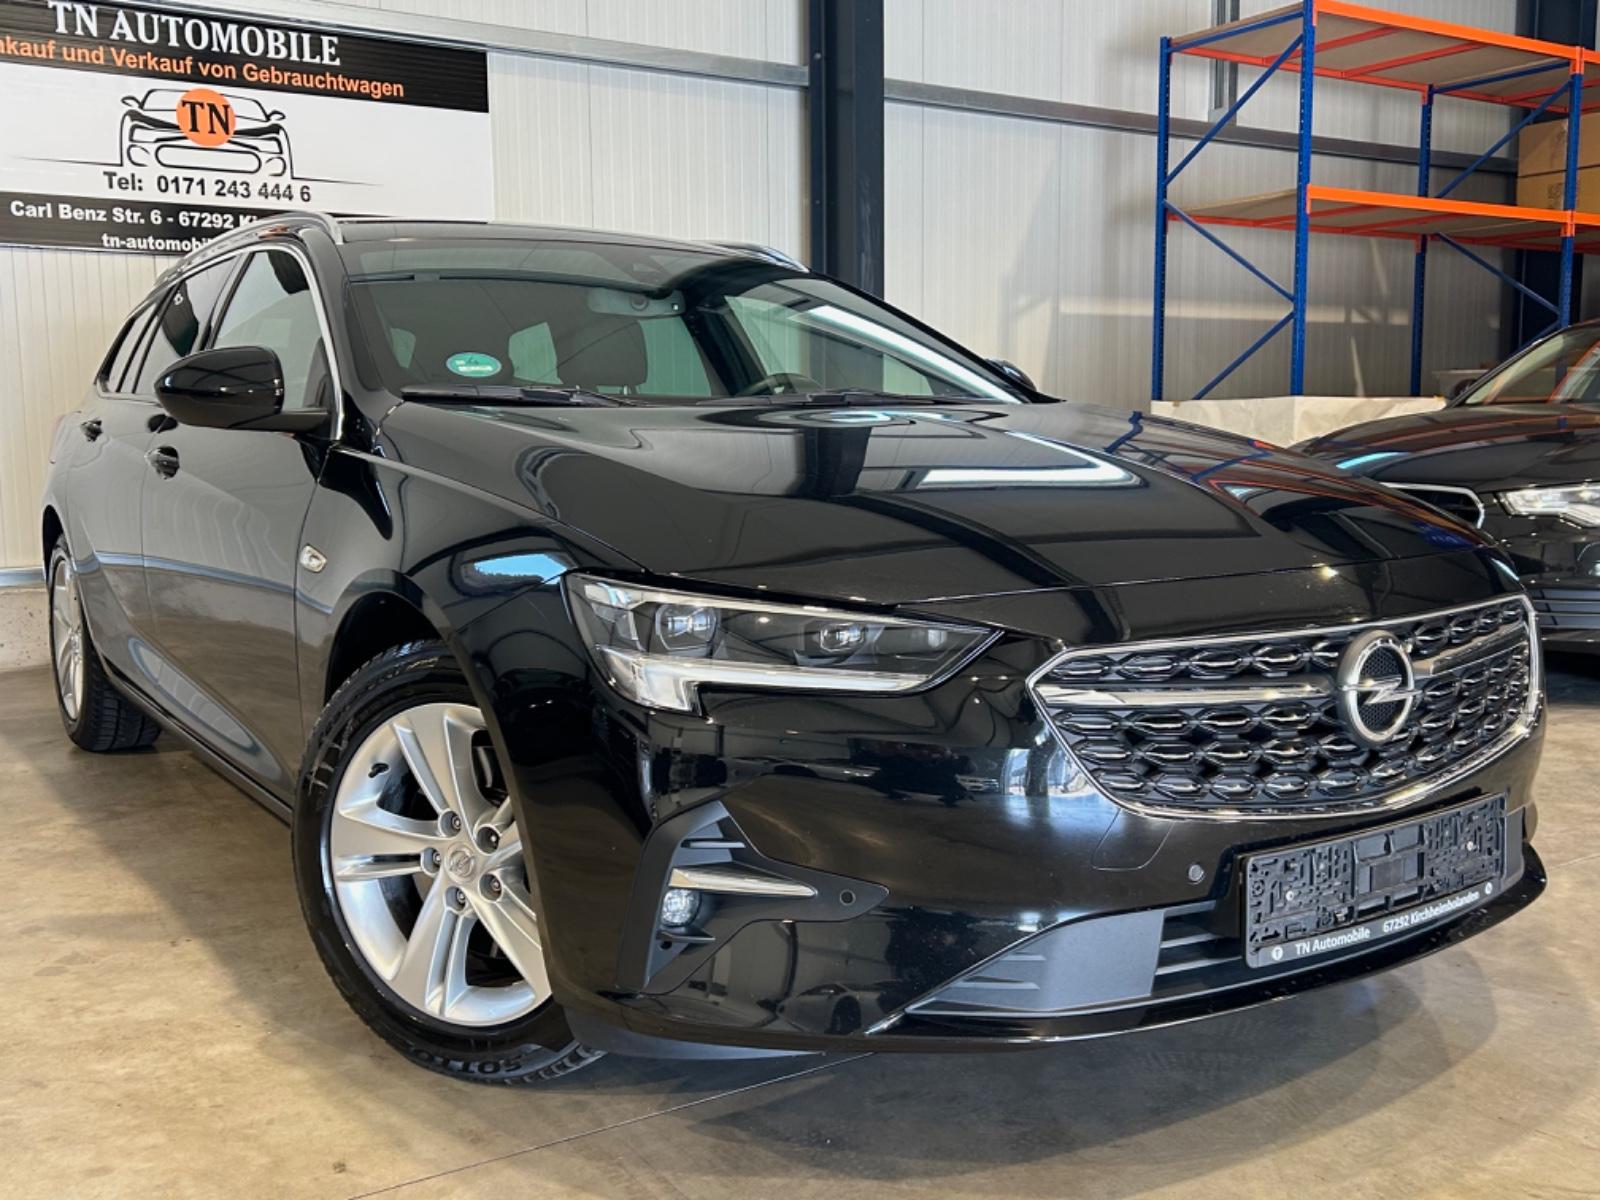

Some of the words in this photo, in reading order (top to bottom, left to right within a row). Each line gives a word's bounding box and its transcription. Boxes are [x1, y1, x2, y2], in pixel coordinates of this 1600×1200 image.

[47, 0, 99, 38] TN
[109, 10, 341, 66] AUTOMOBILE
[63, 46, 105, 65] und
[111, 48, 193, 75] Verkauf
[198, 62, 236, 80] von
[243, 63, 405, 99] Gebrauchtwagen
[181, 99, 231, 136] TN
[103, 171, 144, 192] Tel:
[156, 175, 206, 196] 0171
[214, 179, 251, 199] 243
[258, 182, 294, 201] 444
[300, 185, 312, 203] 6
[10, 200, 53, 219] Carl
[58, 203, 108, 223] Benz
[112, 207, 146, 224] Str.
[150, 209, 163, 225] 6
[178, 211, 234, 229] 67292
[1294, 941, 1310, 956] TN
[1312, 926, 1371, 952] Automobile
